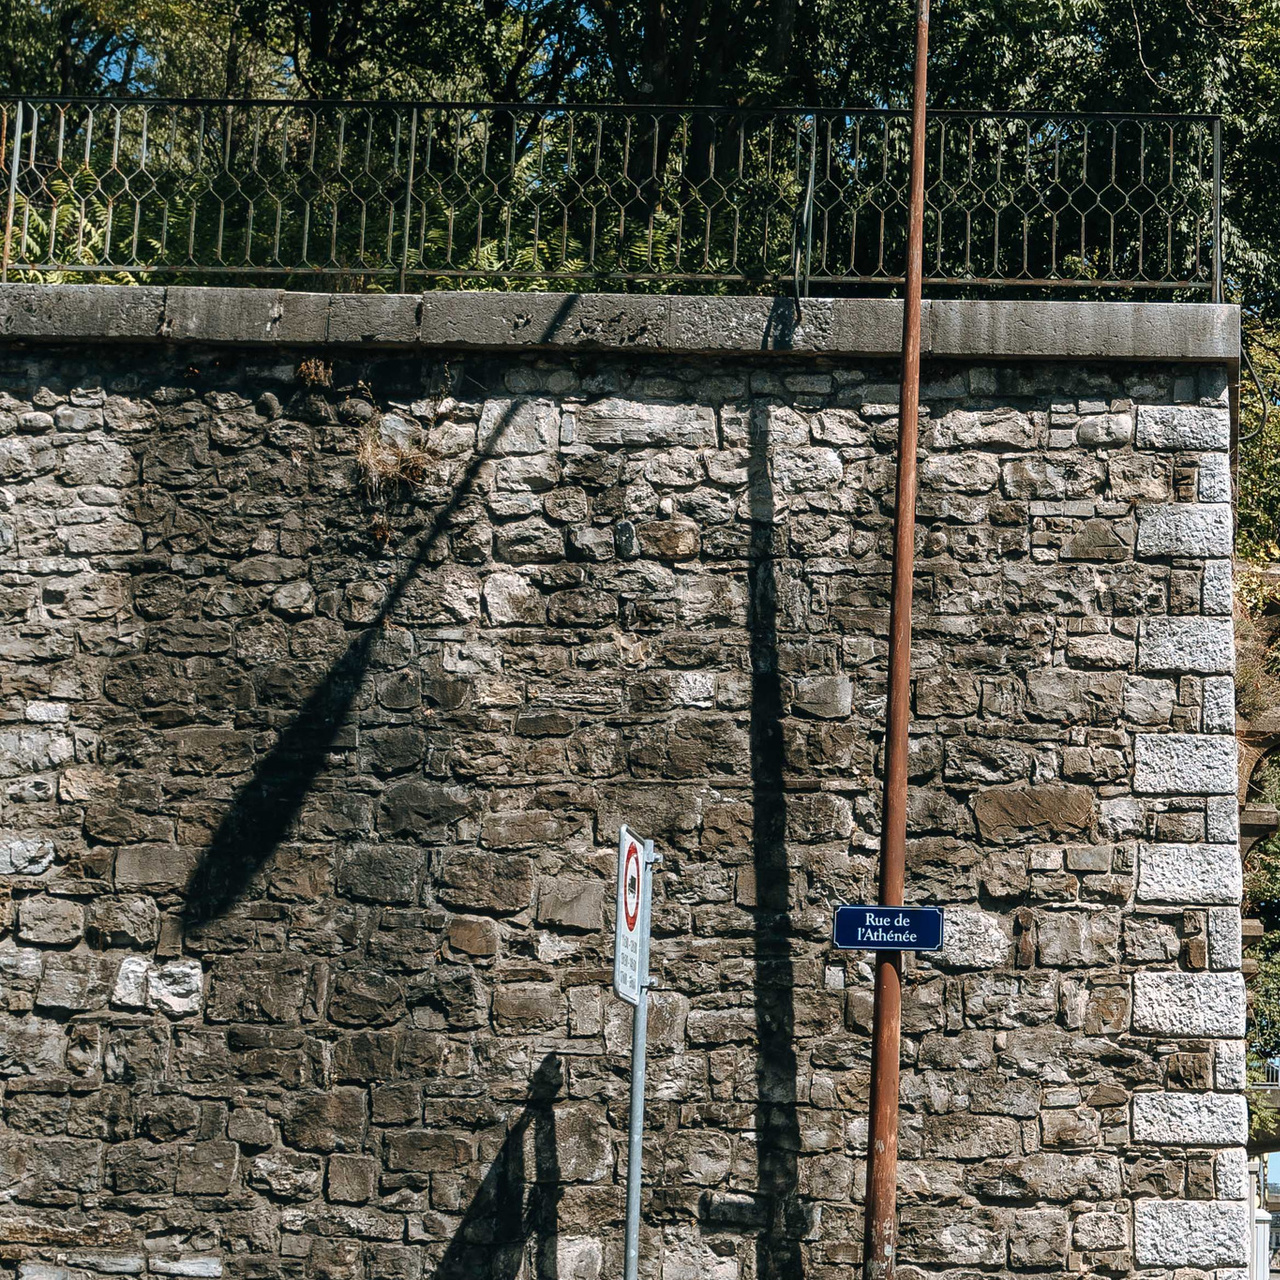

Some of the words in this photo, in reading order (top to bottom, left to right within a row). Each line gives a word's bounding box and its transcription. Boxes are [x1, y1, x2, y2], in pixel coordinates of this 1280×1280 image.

[865, 912, 891, 926] Rue
[894, 913, 910, 927] de
[857, 927, 918, 942] l'Athénée
